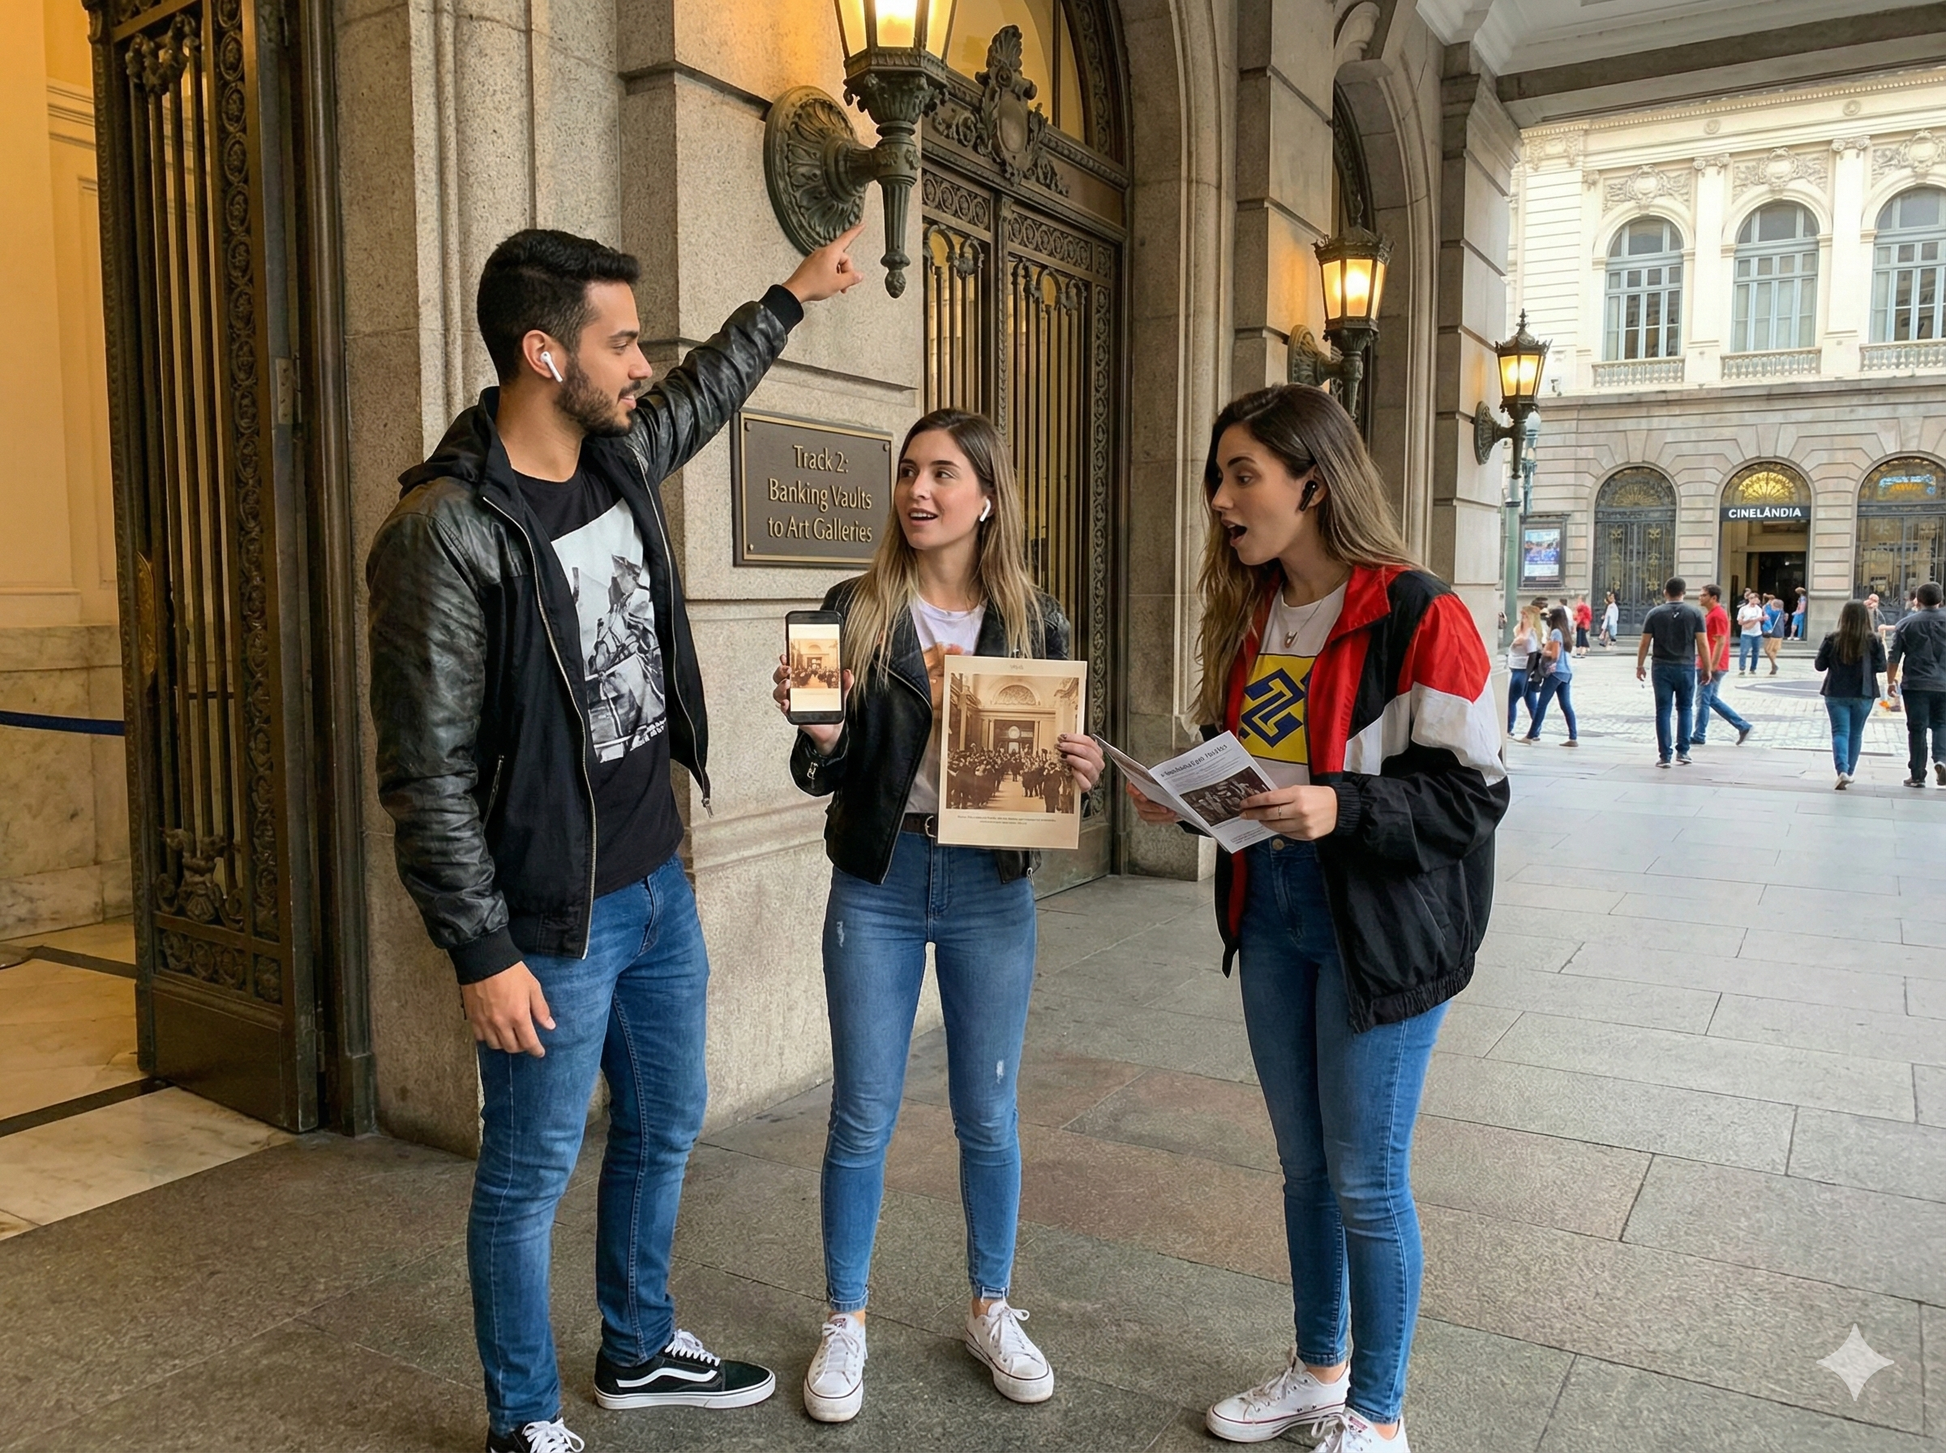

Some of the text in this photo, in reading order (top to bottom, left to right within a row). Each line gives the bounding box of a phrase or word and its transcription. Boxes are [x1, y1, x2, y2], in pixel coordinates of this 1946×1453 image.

[793, 445, 849, 473] Track 2:
[769, 478, 873, 513] Banking Vaults
[768, 516, 873, 543] to Art Galleries
